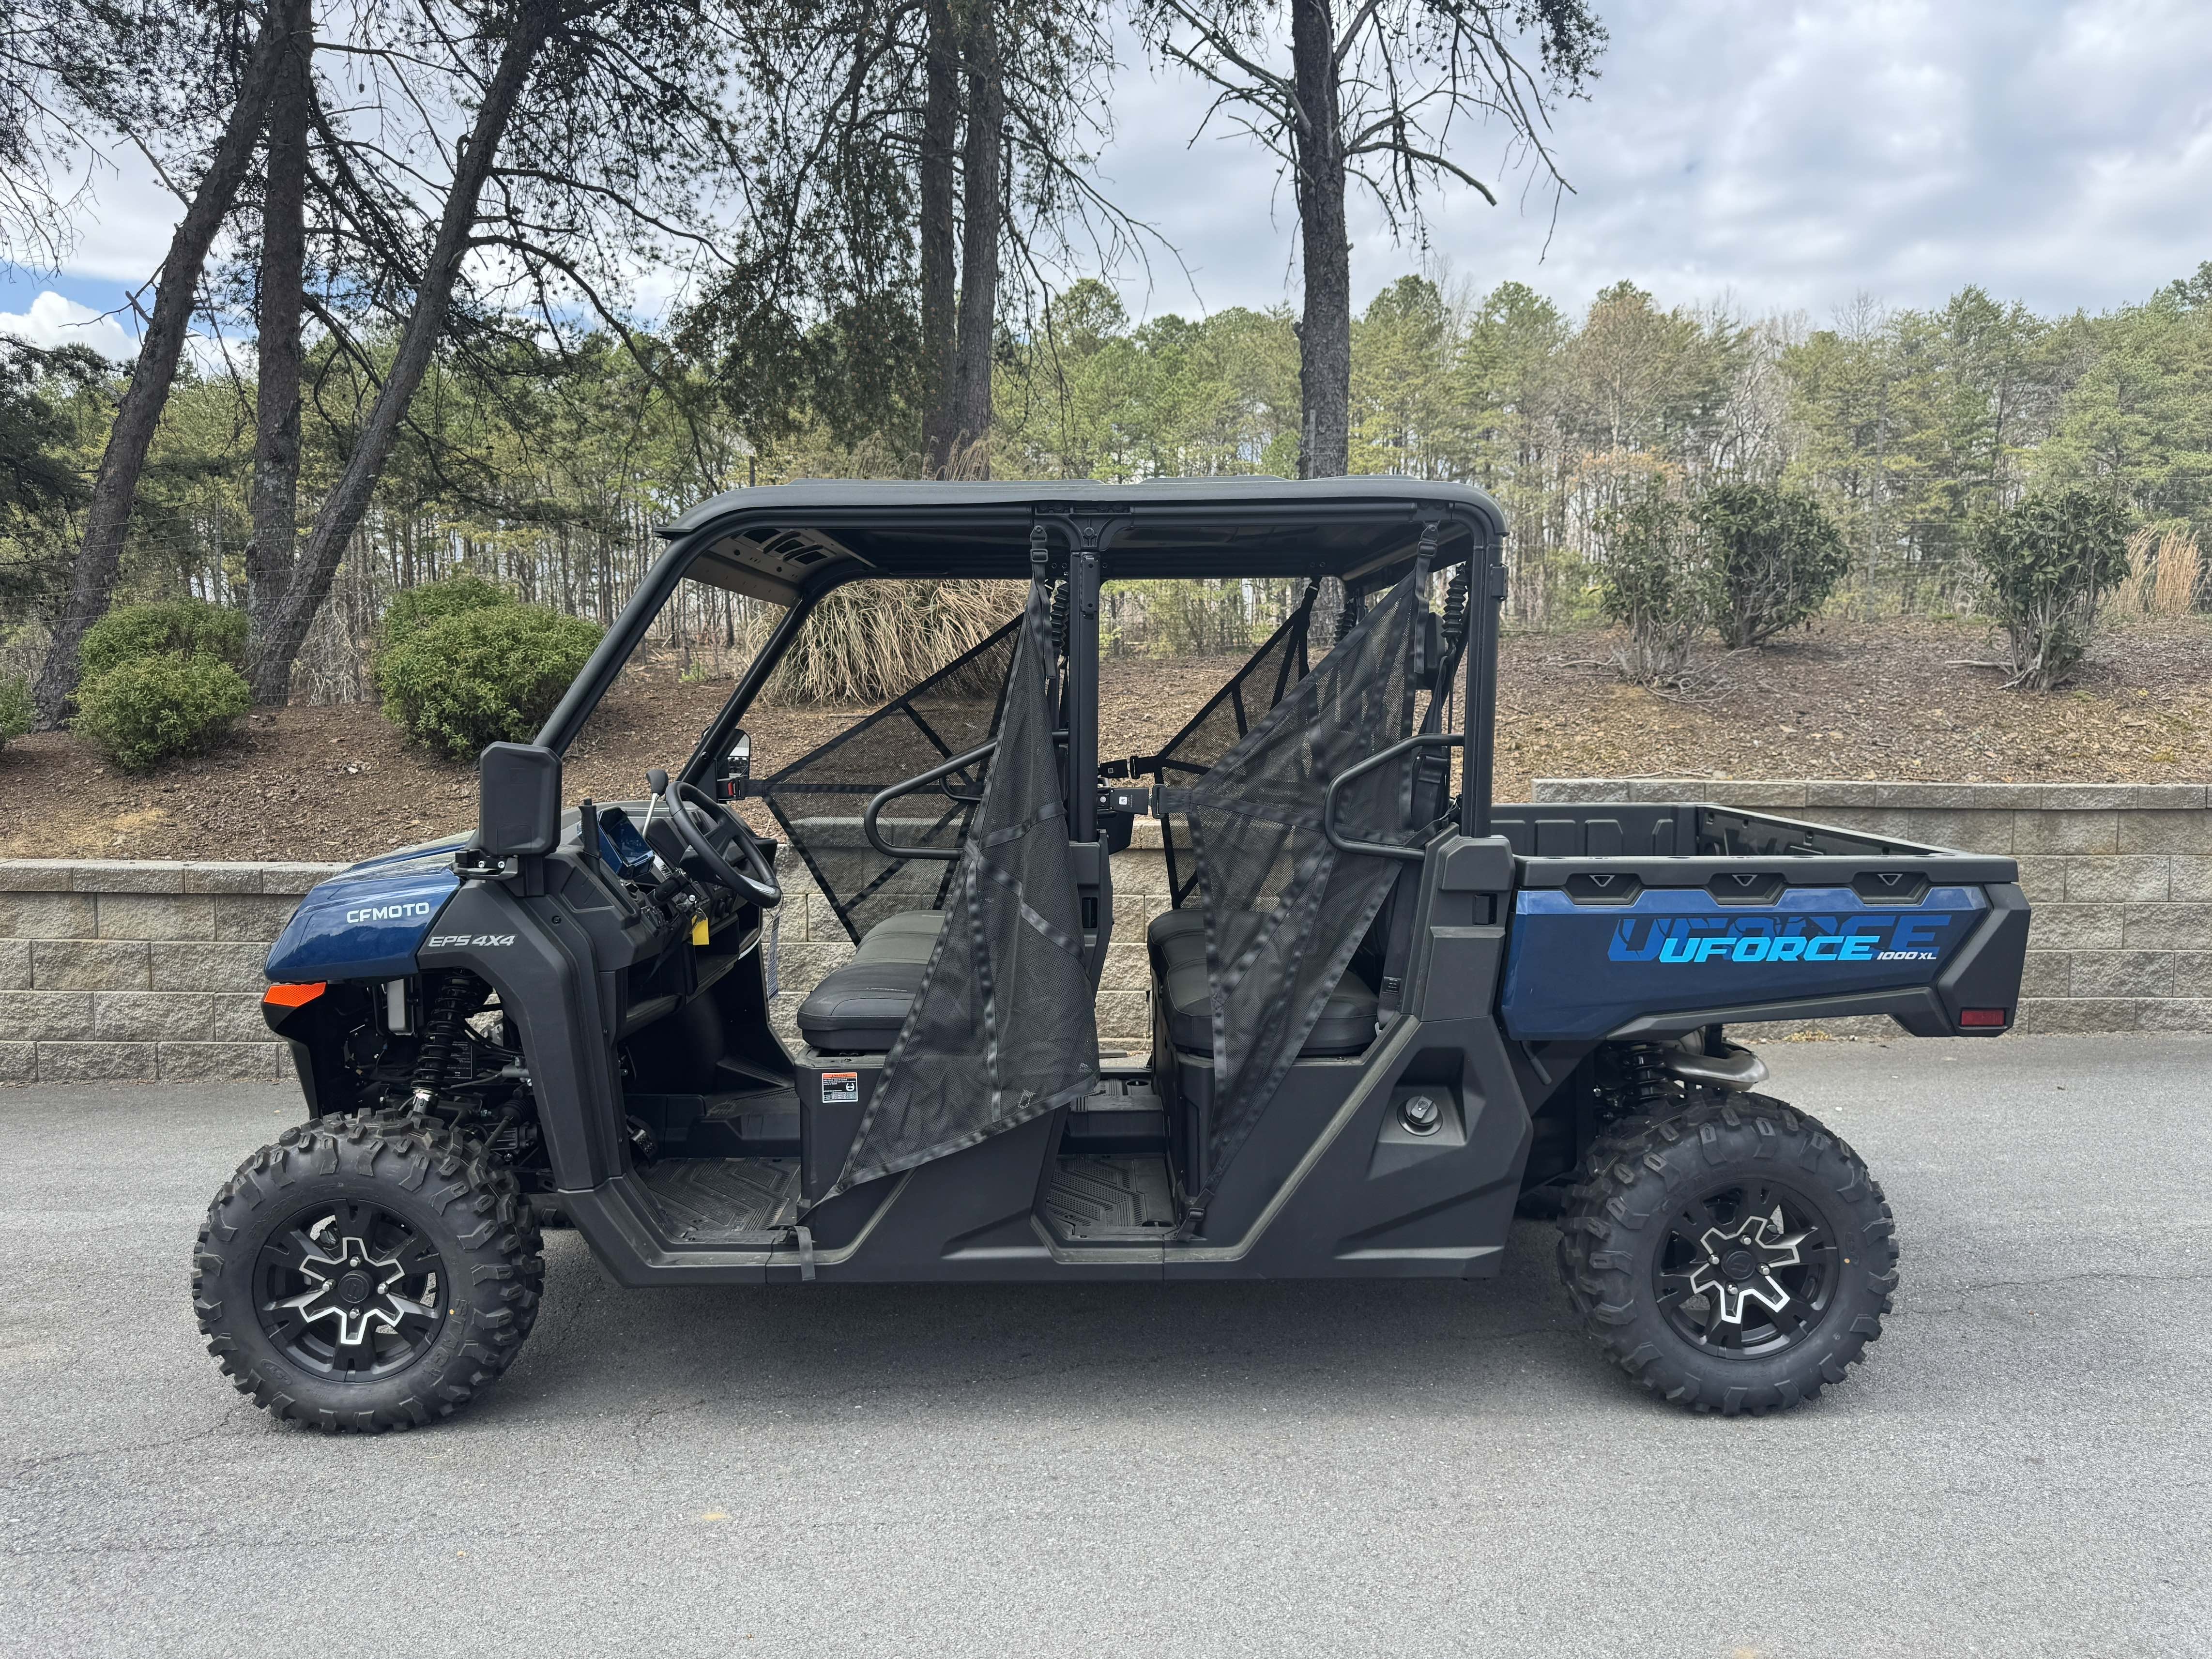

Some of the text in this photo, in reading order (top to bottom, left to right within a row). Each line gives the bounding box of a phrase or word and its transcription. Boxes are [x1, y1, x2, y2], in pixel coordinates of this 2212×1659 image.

[347, 902, 430, 924] CFMOTO
[428, 935, 516, 947] EPS 4X4
[1659, 935, 1880, 963] UFORCE
[1876, 951, 1918, 960] 1000
